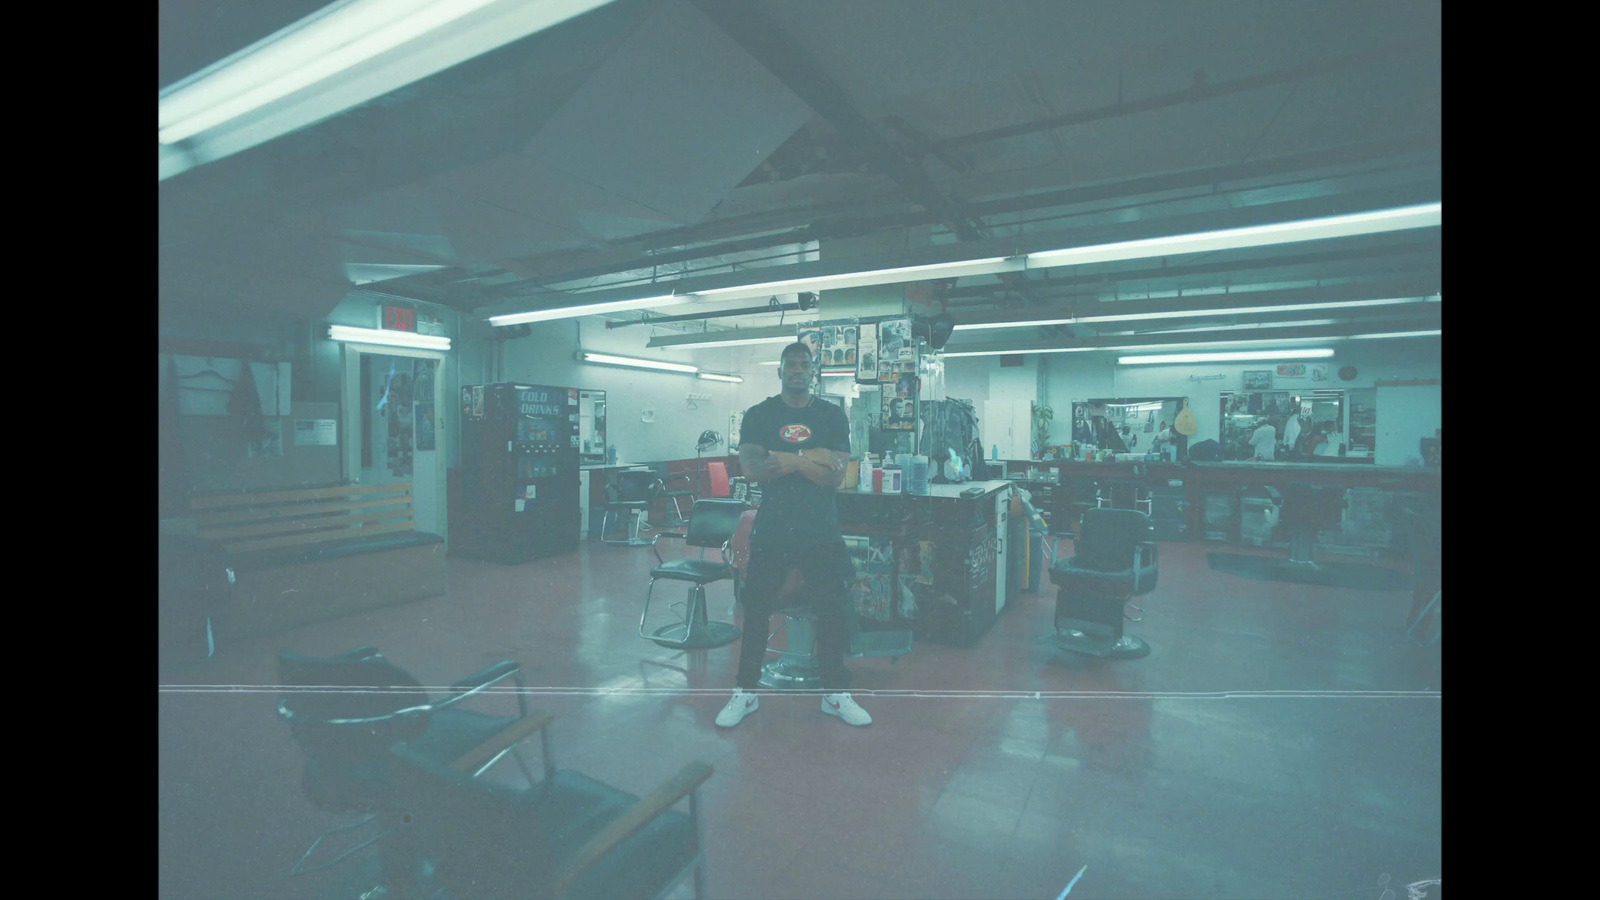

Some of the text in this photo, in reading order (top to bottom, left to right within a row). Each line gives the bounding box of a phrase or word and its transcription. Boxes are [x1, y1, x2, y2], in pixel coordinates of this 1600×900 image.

[385, 306, 415, 331] EXIT
[521, 390, 548, 403] COLD
[521, 403, 560, 416] DRINKS
